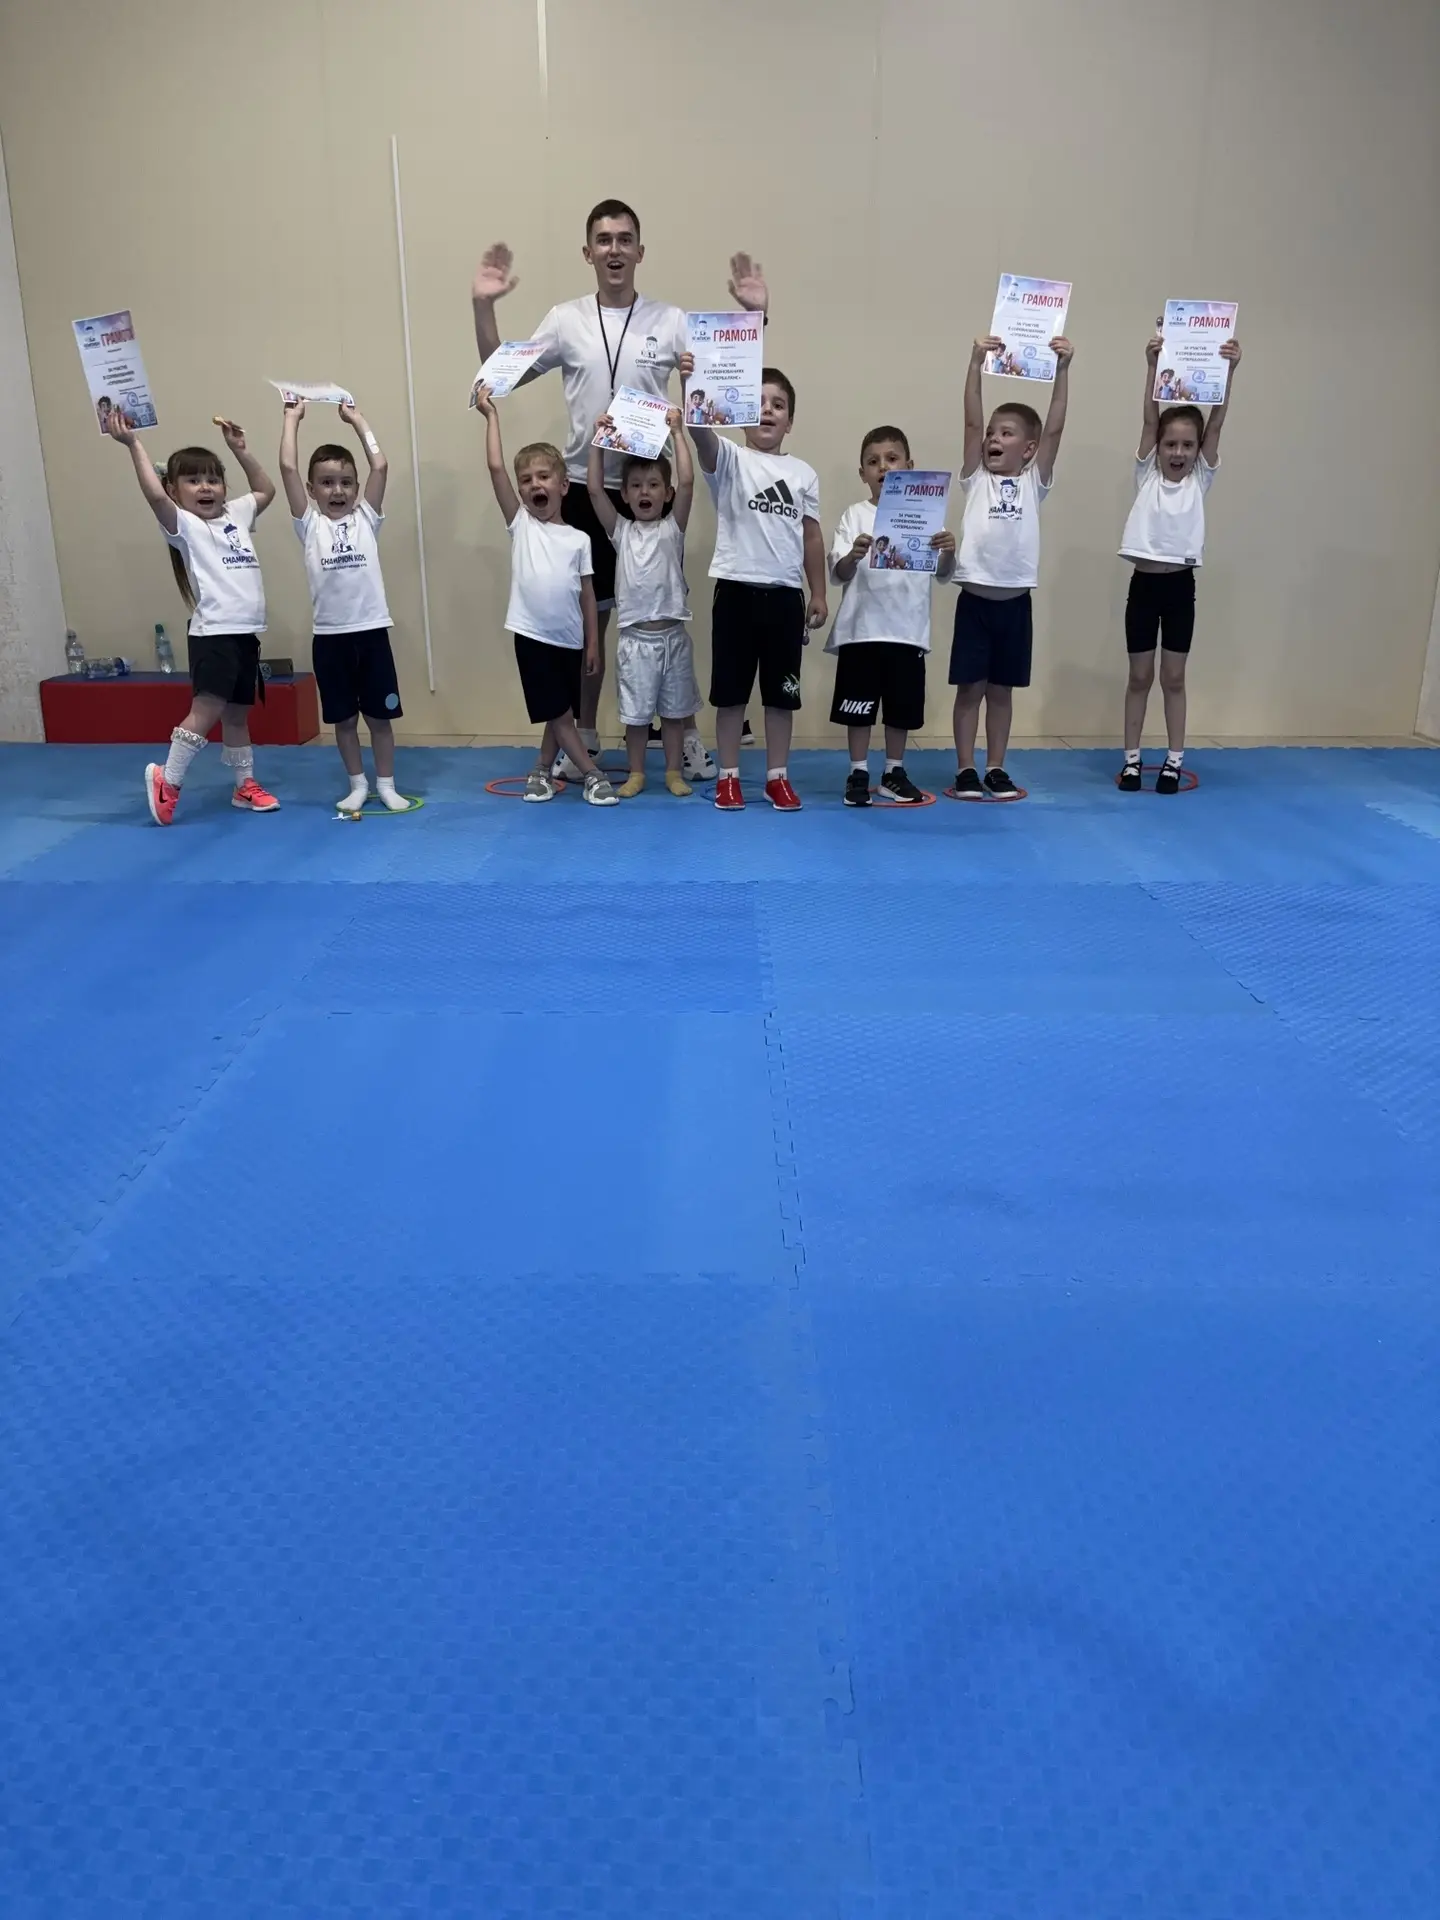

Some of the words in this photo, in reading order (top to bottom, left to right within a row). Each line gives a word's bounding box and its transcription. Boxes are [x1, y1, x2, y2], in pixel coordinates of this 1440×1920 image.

[1022, 294, 1063, 308] ГРАМОТА
[1188, 316, 1230, 329] ГРАМОТА
[713, 329, 758, 342] ГРАМОТА
[637, 399, 671, 412] ГРАМОТ
[903, 484, 945, 497] ГРАМОТА
[748, 499, 799, 520] adidas
[321, 556, 353, 565] CHAMPION
[839, 699, 875, 715] NIKE
